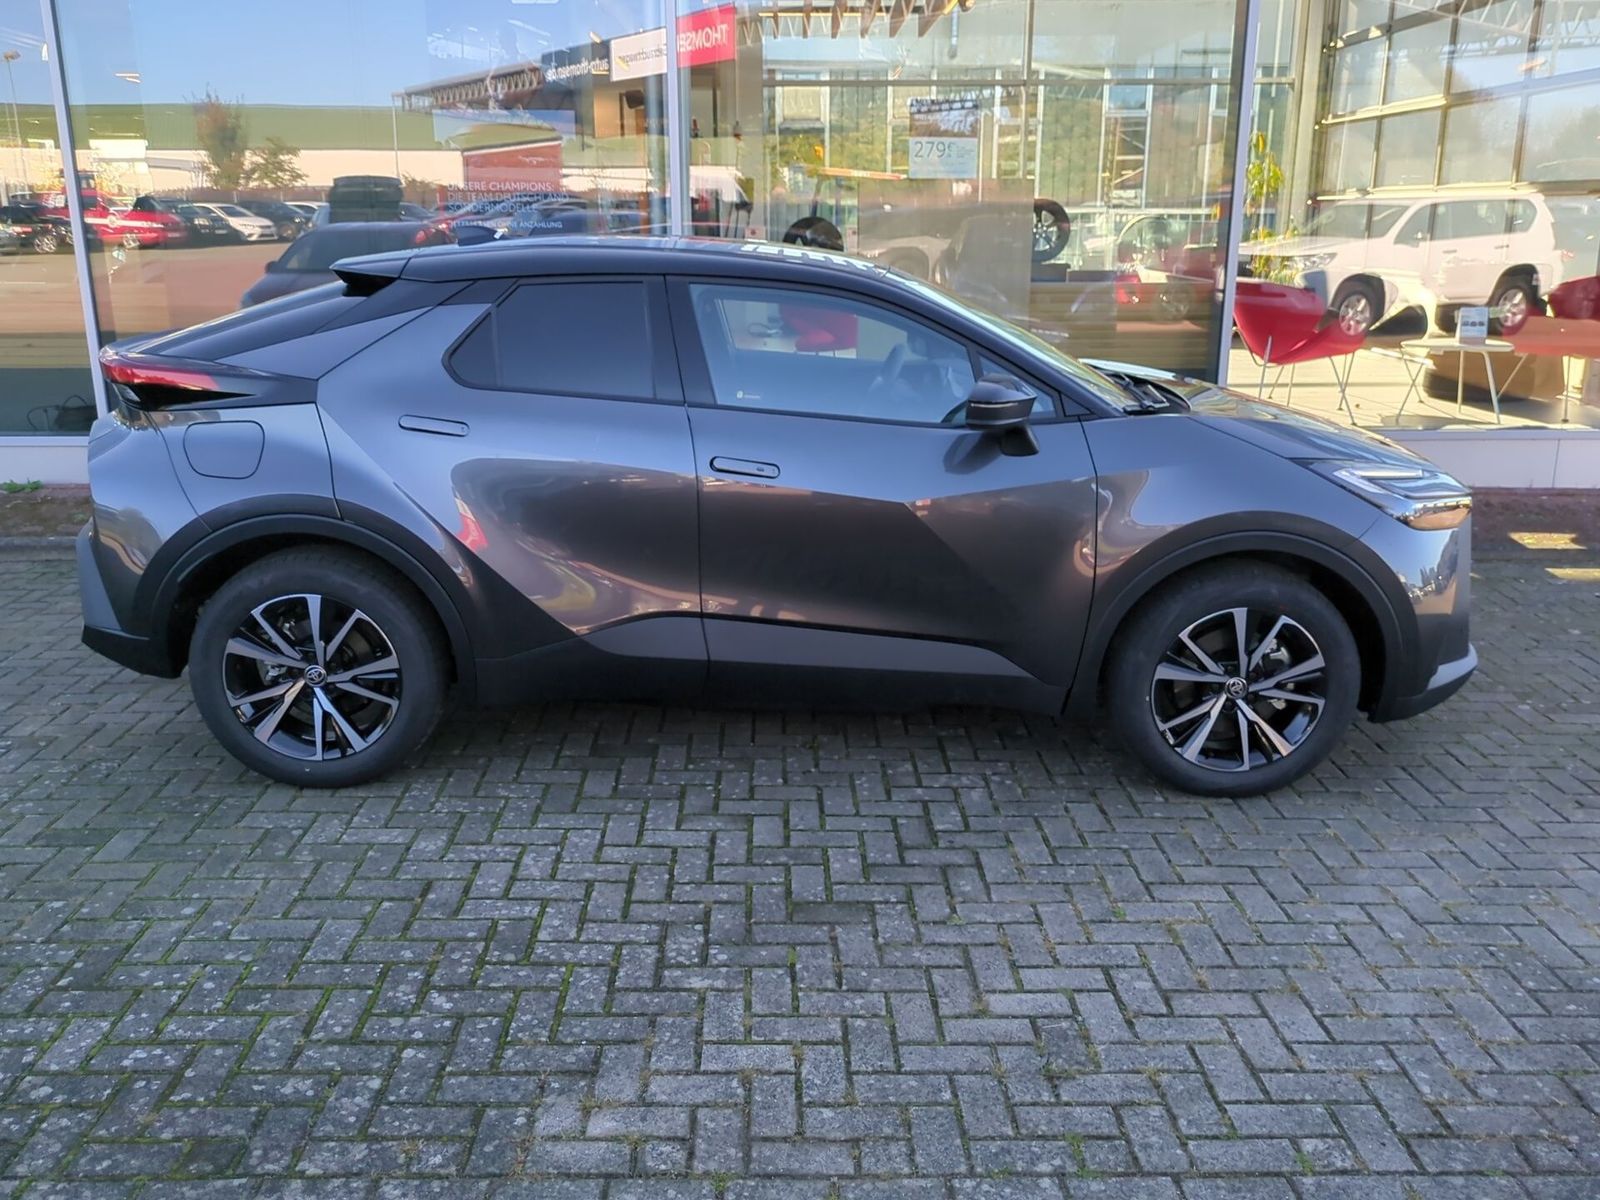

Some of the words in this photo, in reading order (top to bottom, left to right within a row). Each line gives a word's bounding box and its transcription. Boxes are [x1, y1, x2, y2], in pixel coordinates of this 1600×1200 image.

[447, 192, 463, 201] DIE
[448, 202, 538, 213] SONDERMODELLE
[519, 221, 563, 229] ANZAHLUNG
